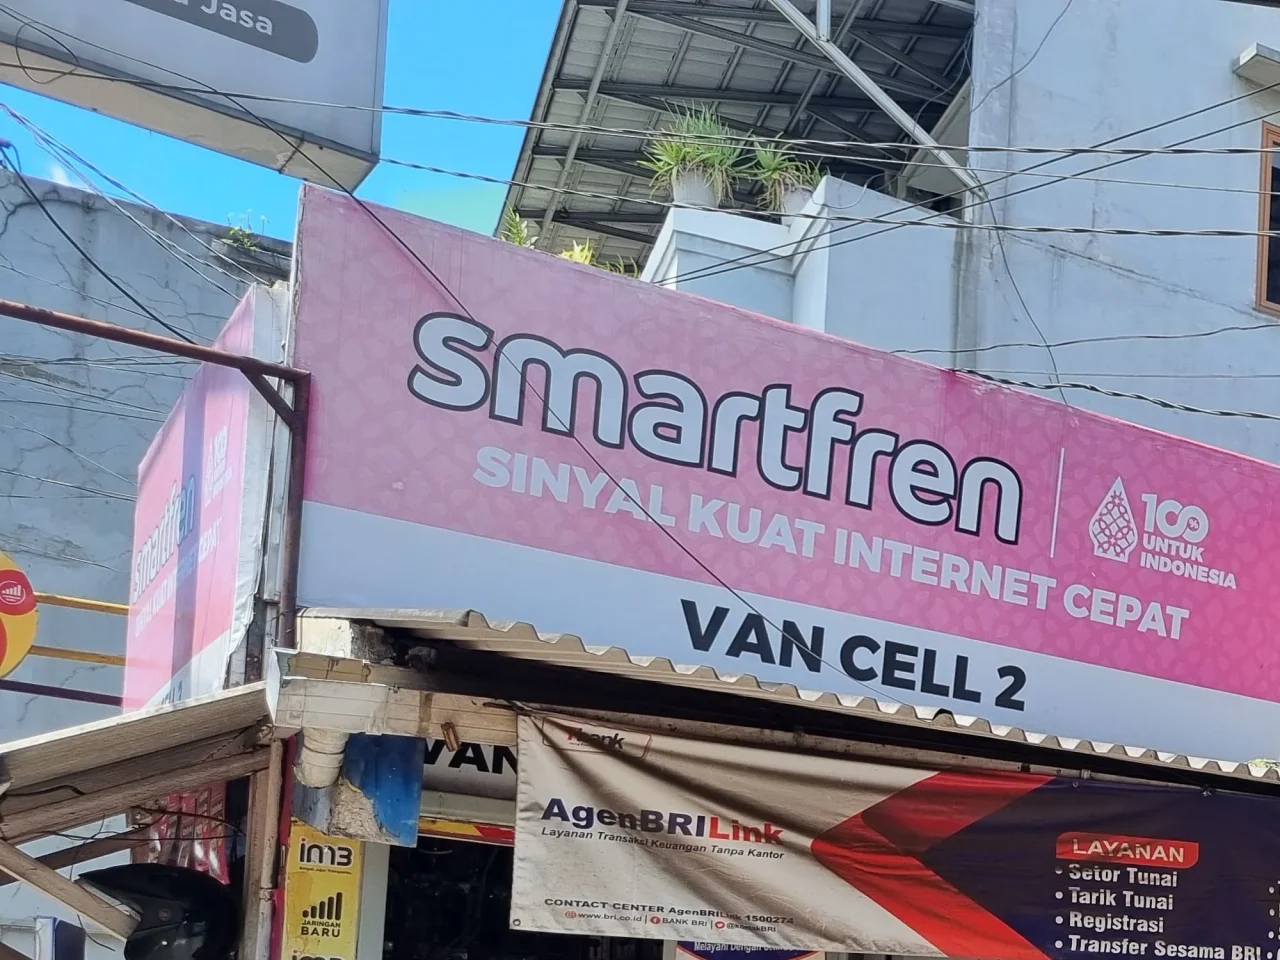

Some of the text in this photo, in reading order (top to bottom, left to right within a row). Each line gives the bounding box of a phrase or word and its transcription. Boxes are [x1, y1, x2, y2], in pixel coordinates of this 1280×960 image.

[408, 312, 1022, 545] smartfren
[473, 446, 1190, 640] SINYAL KUAT INTERNET CEPAT
[1142, 533, 1204, 563] UNTUK
[1140, 551, 1237, 589] INDONESIA
[681, 599, 1028, 712] VAN CELL 2
[541, 798, 784, 846] AgenBRILink
[299, 838, 353, 867] im3
[541, 826, 785, 860] Layanan Transaksi Keuangan Tanpa Kantor
[1072, 838, 1185, 864] LAYANAN
[1069, 865, 1178, 888] Setor Tunai
[544, 898, 608, 910] CONTACT
[612, 902, 665, 914] CENTER
[744, 914, 795, 925] 1500274
[1069, 887, 1174, 911] Tarik Tunai
[301, 927, 340, 938] BARU
[302, 920, 341, 928] JARINGAN
[662, 917, 688, 926] BANK
[691, 919, 708, 927] BRI
[1069, 912, 1164, 934] Registrasi
[1068, 935, 1148, 957] Transfer
[1154, 940, 1225, 960] Sesama
